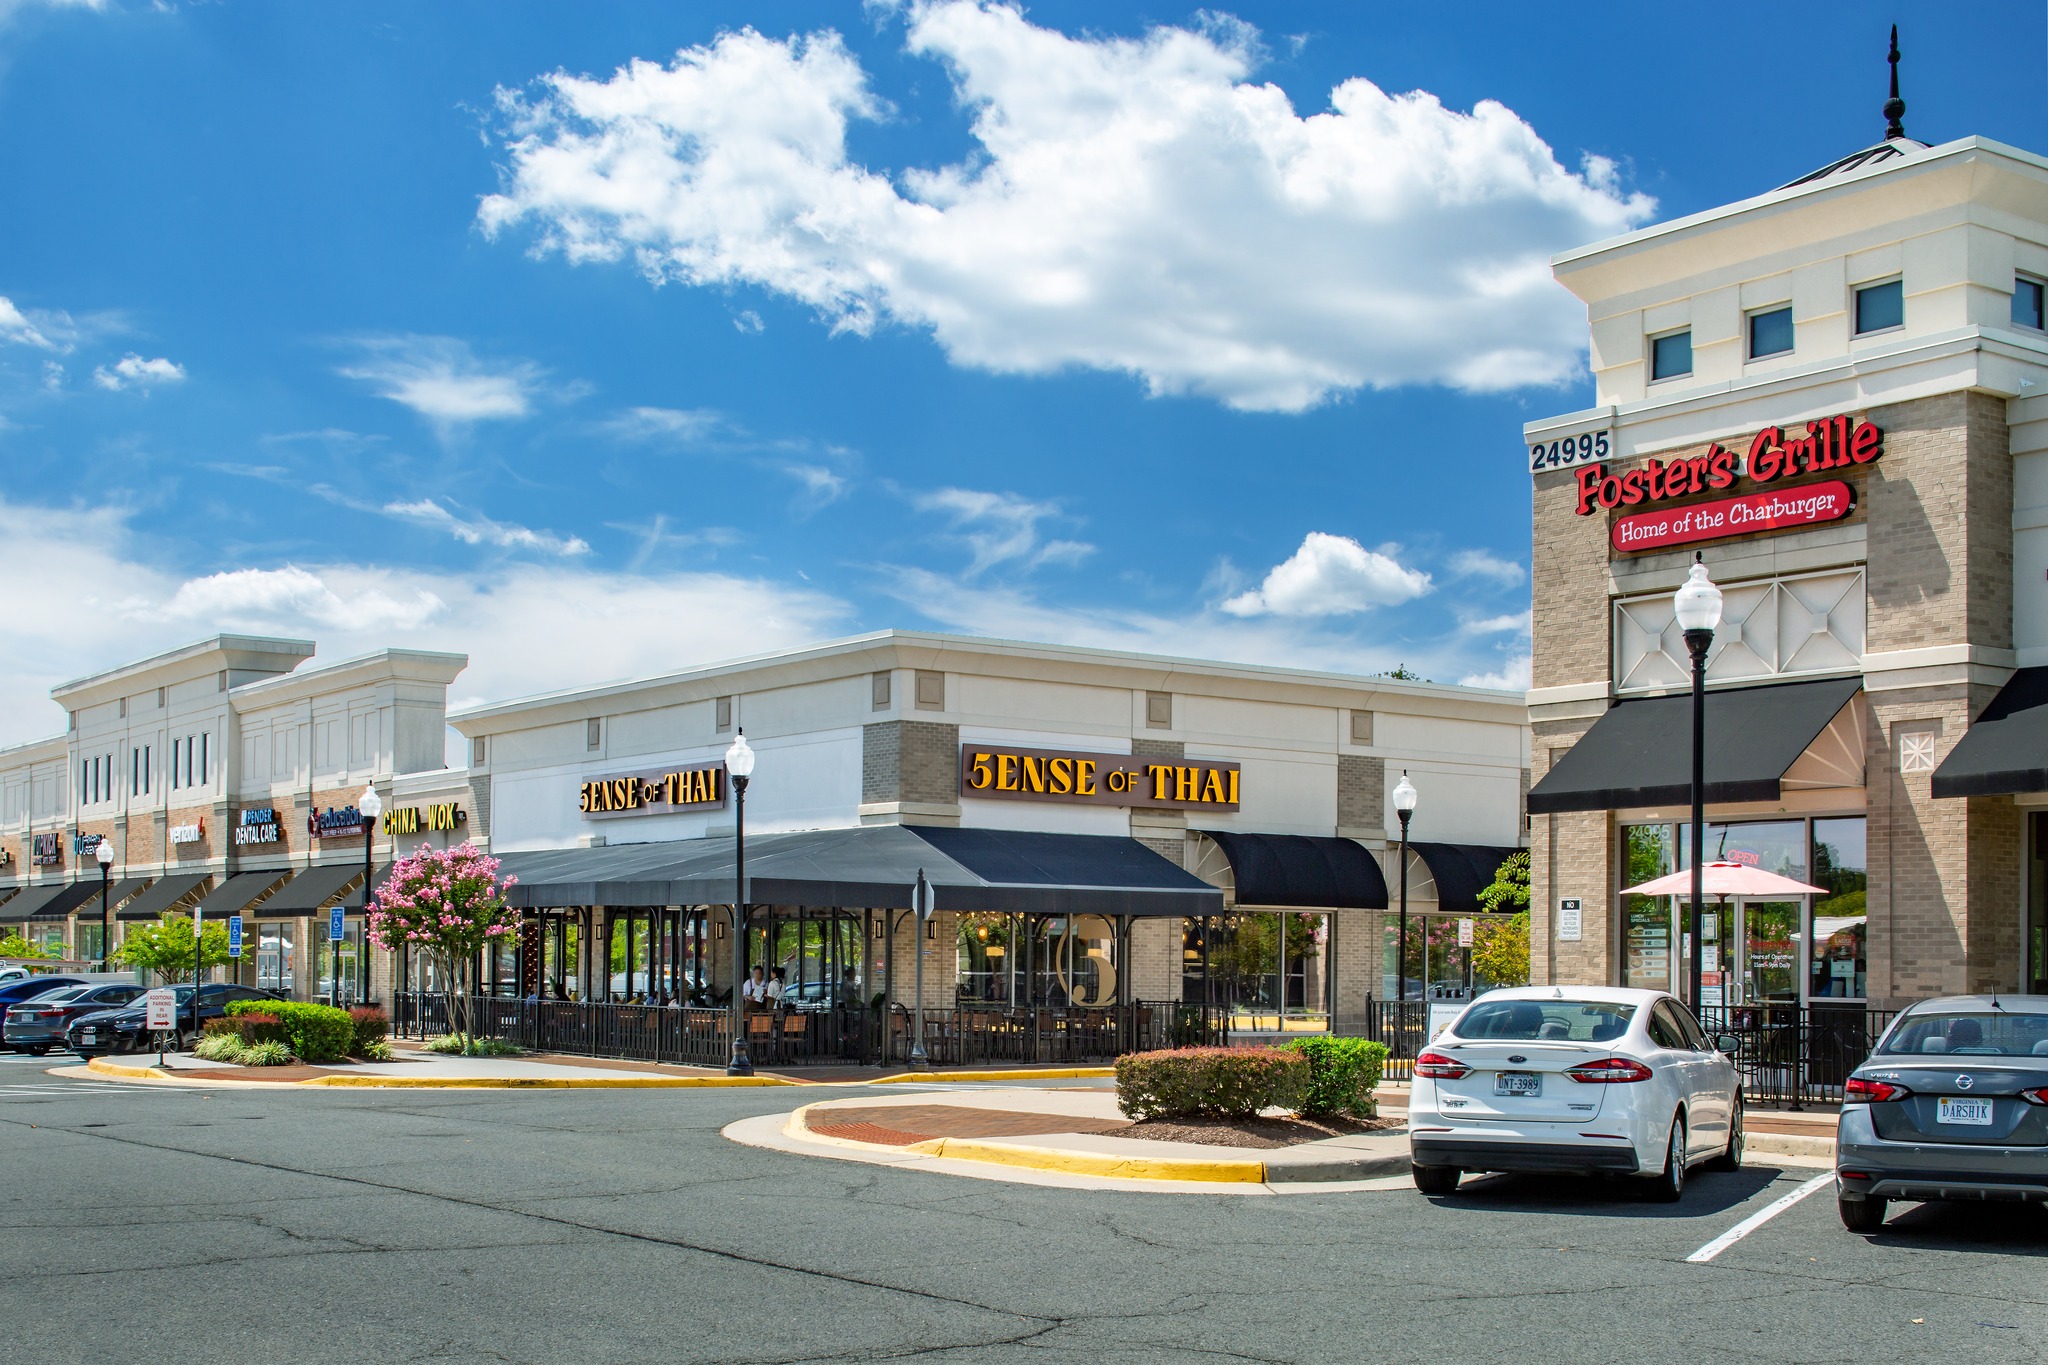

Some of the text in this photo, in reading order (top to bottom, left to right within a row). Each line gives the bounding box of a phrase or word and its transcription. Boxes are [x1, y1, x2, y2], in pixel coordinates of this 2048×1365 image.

[1532, 430, 1609, 470] 24995
[1574, 414, 1883, 516] Foster's Grille
[1620, 494, 1836, 543] Home of the Charburger
[970, 752, 1239, 805] 5ENSE OF THAI
[580, 768, 717, 813] 5ENSE OF THAI
[247, 809, 272, 825] PENDER
[320, 805, 363, 829] education
[383, 802, 456, 836] CHINA WOK
[170, 821, 200, 844] verizon
[236, 824, 278, 845] DENTAL CARE
[1628, 825, 1671, 841] 24995
[1727, 849, 1760, 865] OPEN
[1566, 901, 1575, 909] NO
[1498, 1078, 1539, 1090] UNT-3989
[1942, 1105, 1988, 1119] DARSHIK
